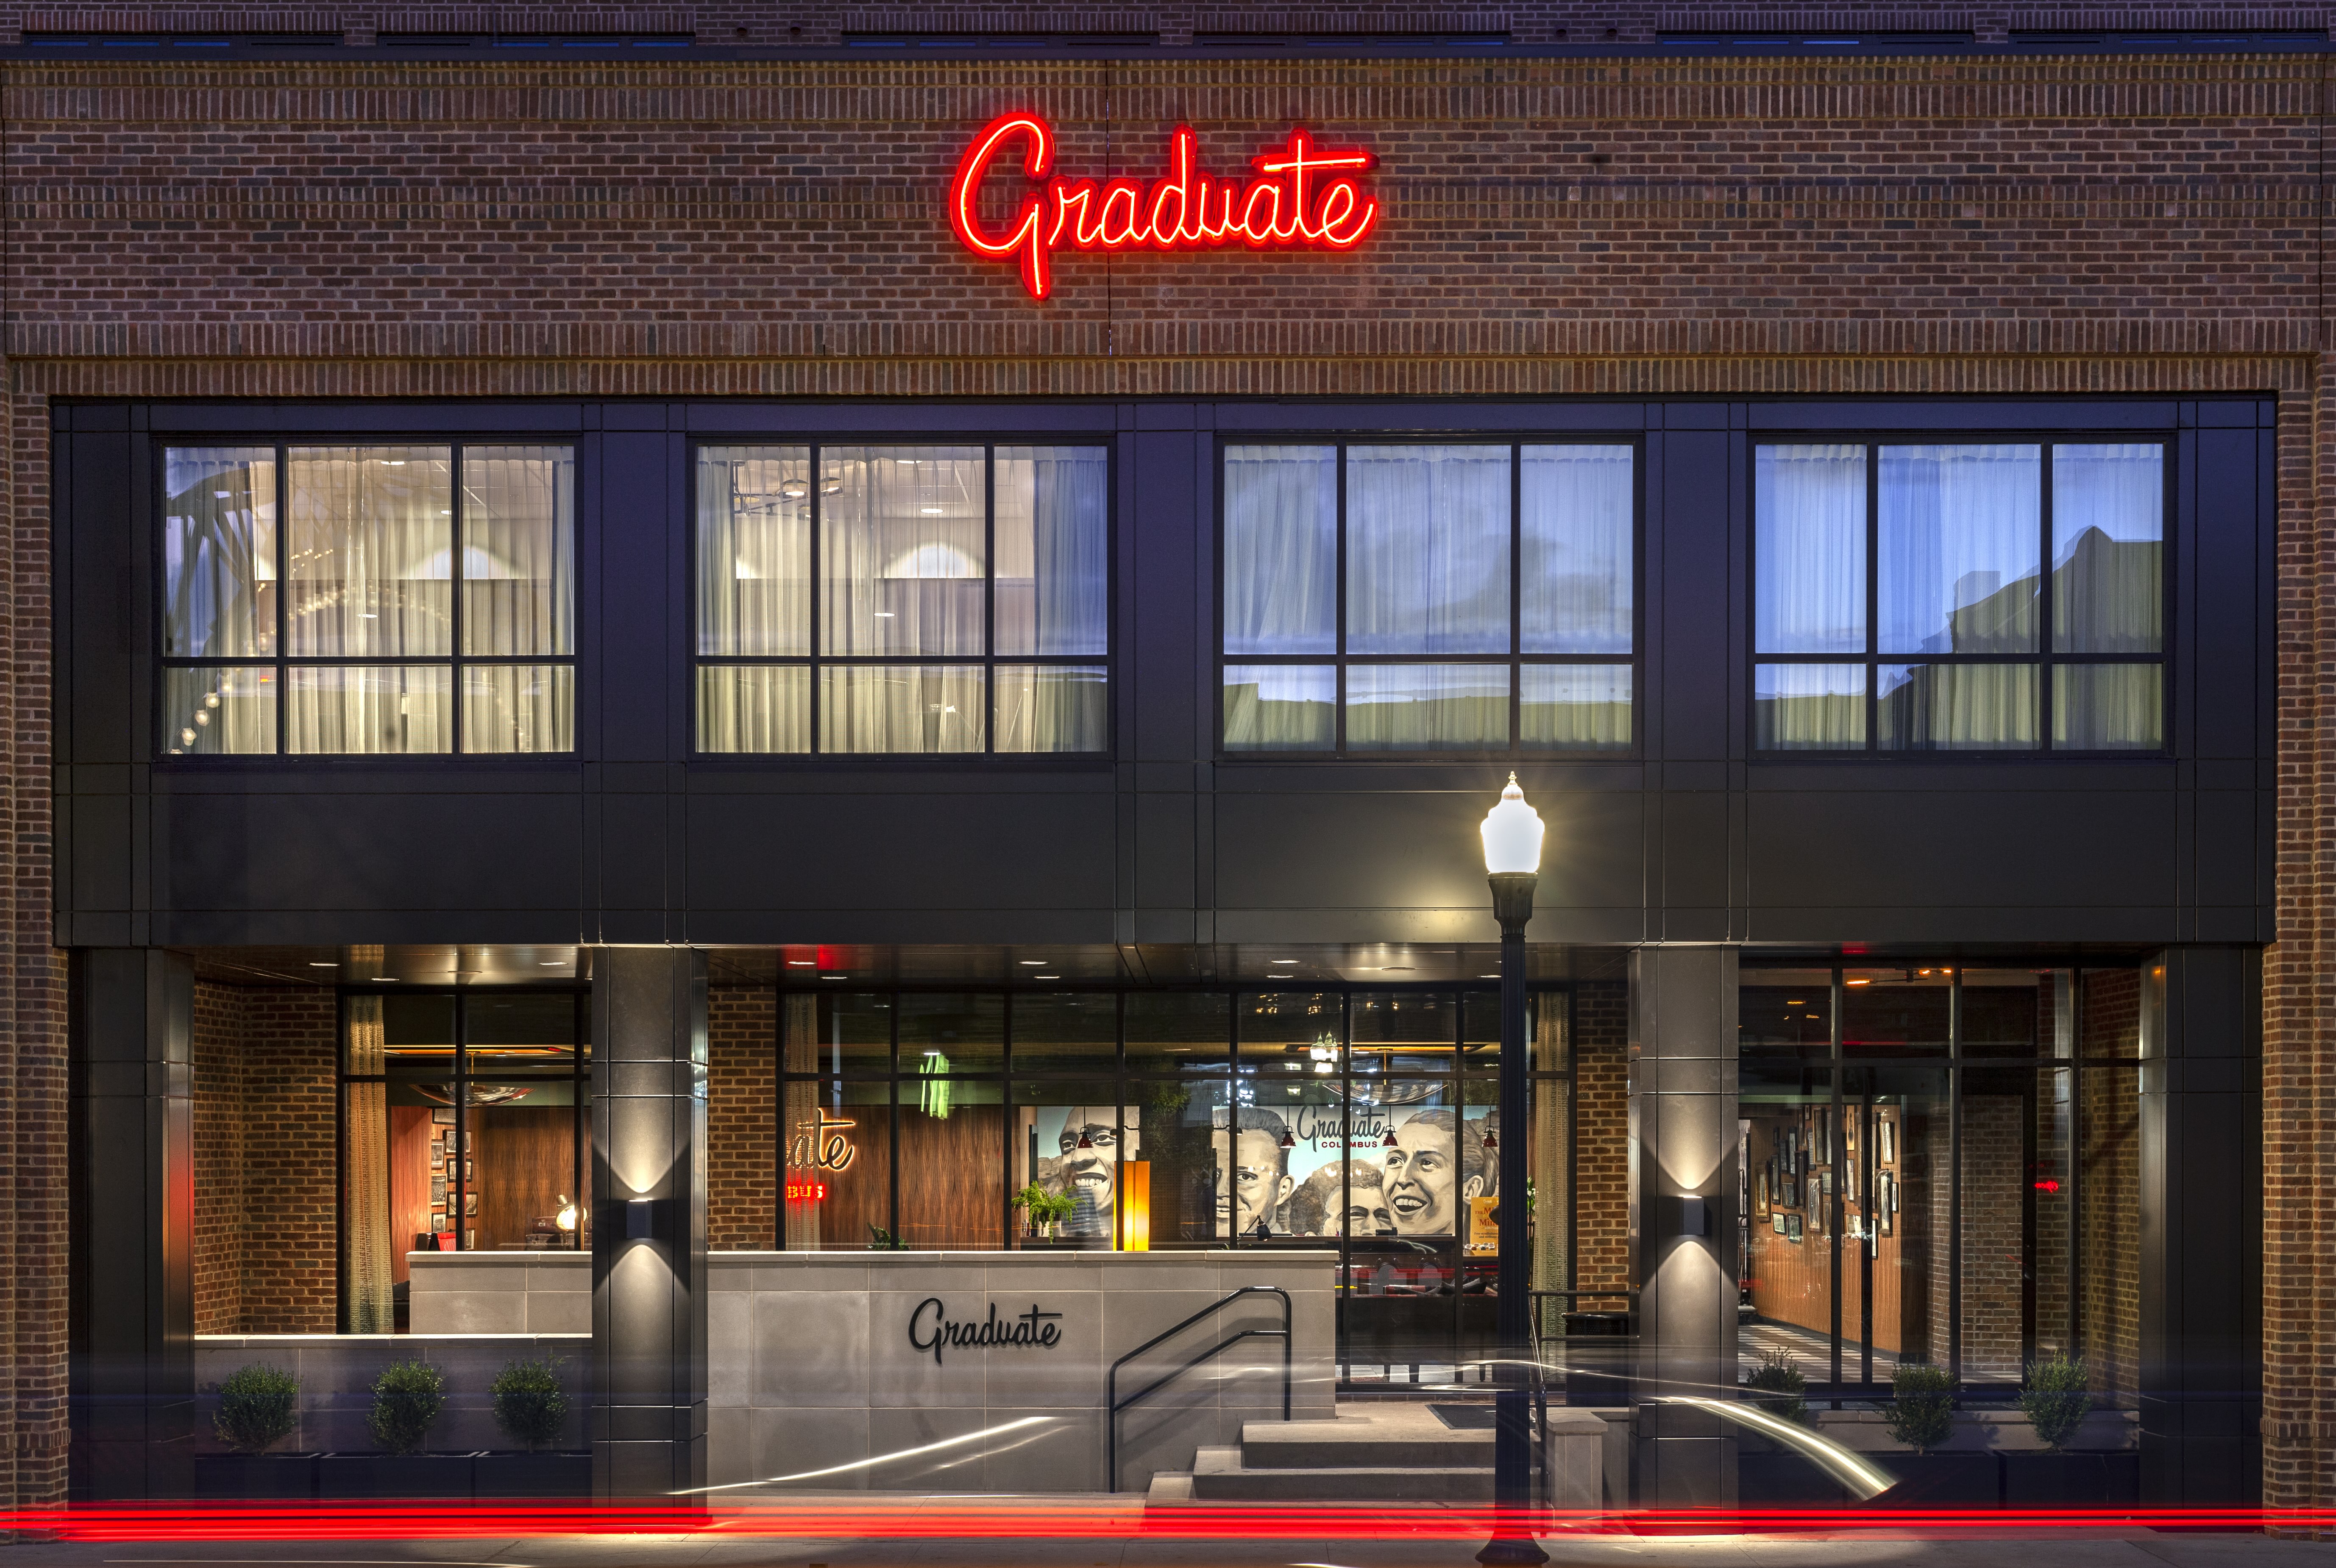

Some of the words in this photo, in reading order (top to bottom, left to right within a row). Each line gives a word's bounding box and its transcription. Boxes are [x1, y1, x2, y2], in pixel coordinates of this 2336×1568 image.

[950, 112, 1379, 300] Graduate
[1297, 1104, 1385, 1152] Graate
[909, 1298, 1063, 1364] Graduate
